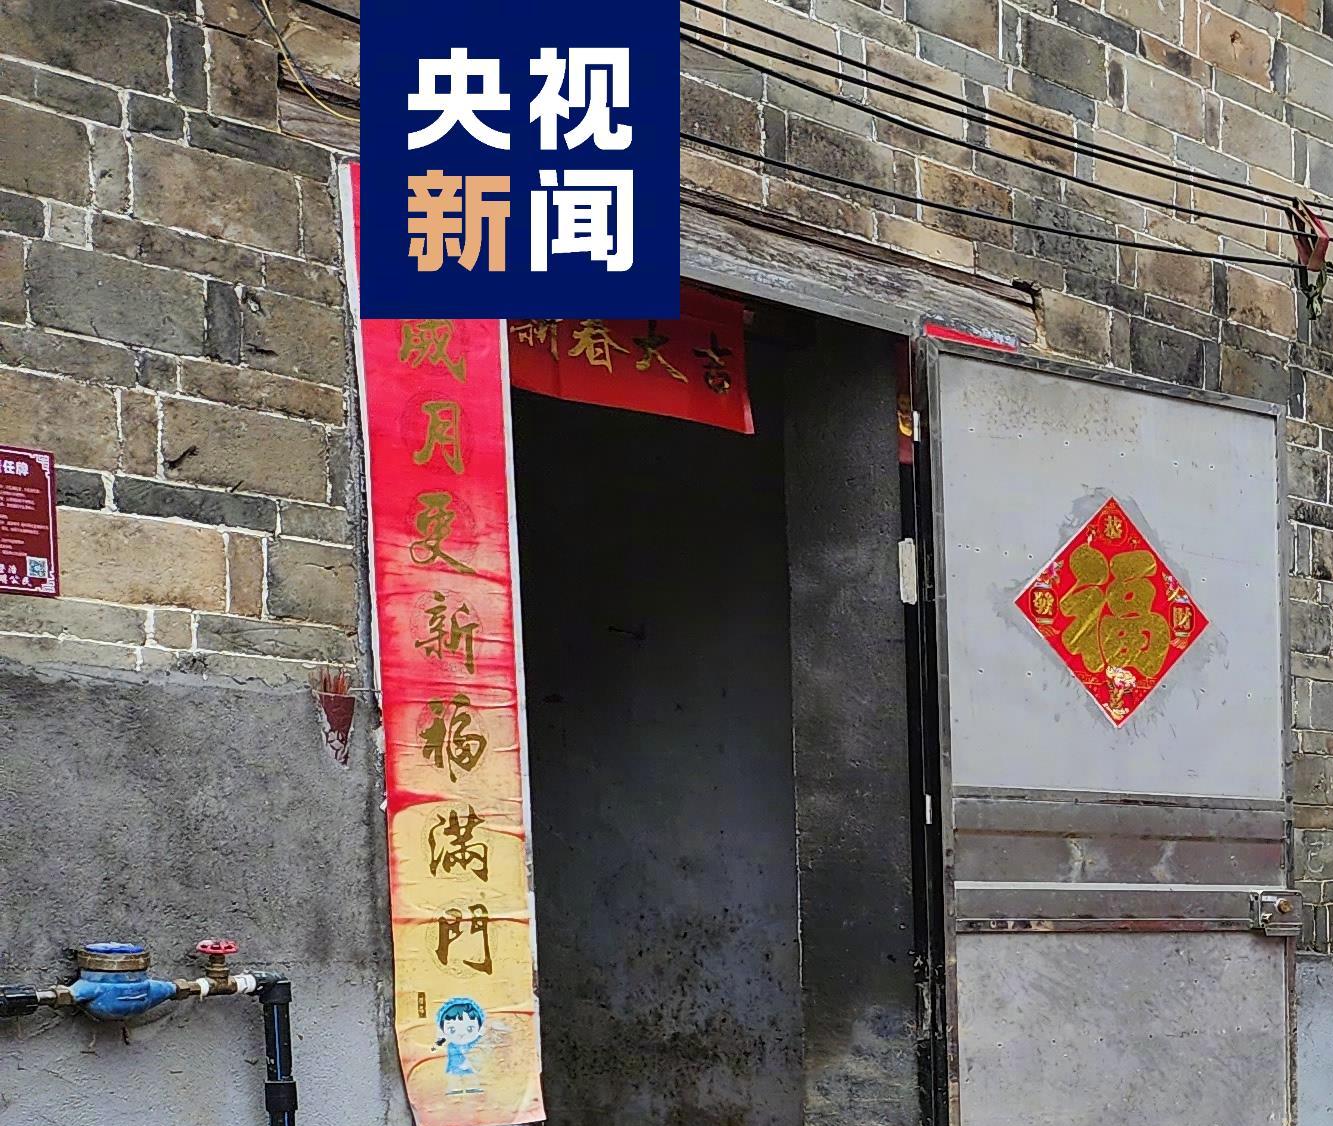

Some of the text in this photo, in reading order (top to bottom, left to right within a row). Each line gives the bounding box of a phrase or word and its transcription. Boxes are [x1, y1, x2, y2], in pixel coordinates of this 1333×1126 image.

[0, 460, 29, 476] 任牌
[1060, 543, 1170, 678] 福
[1172, 606, 1192, 629] 財
